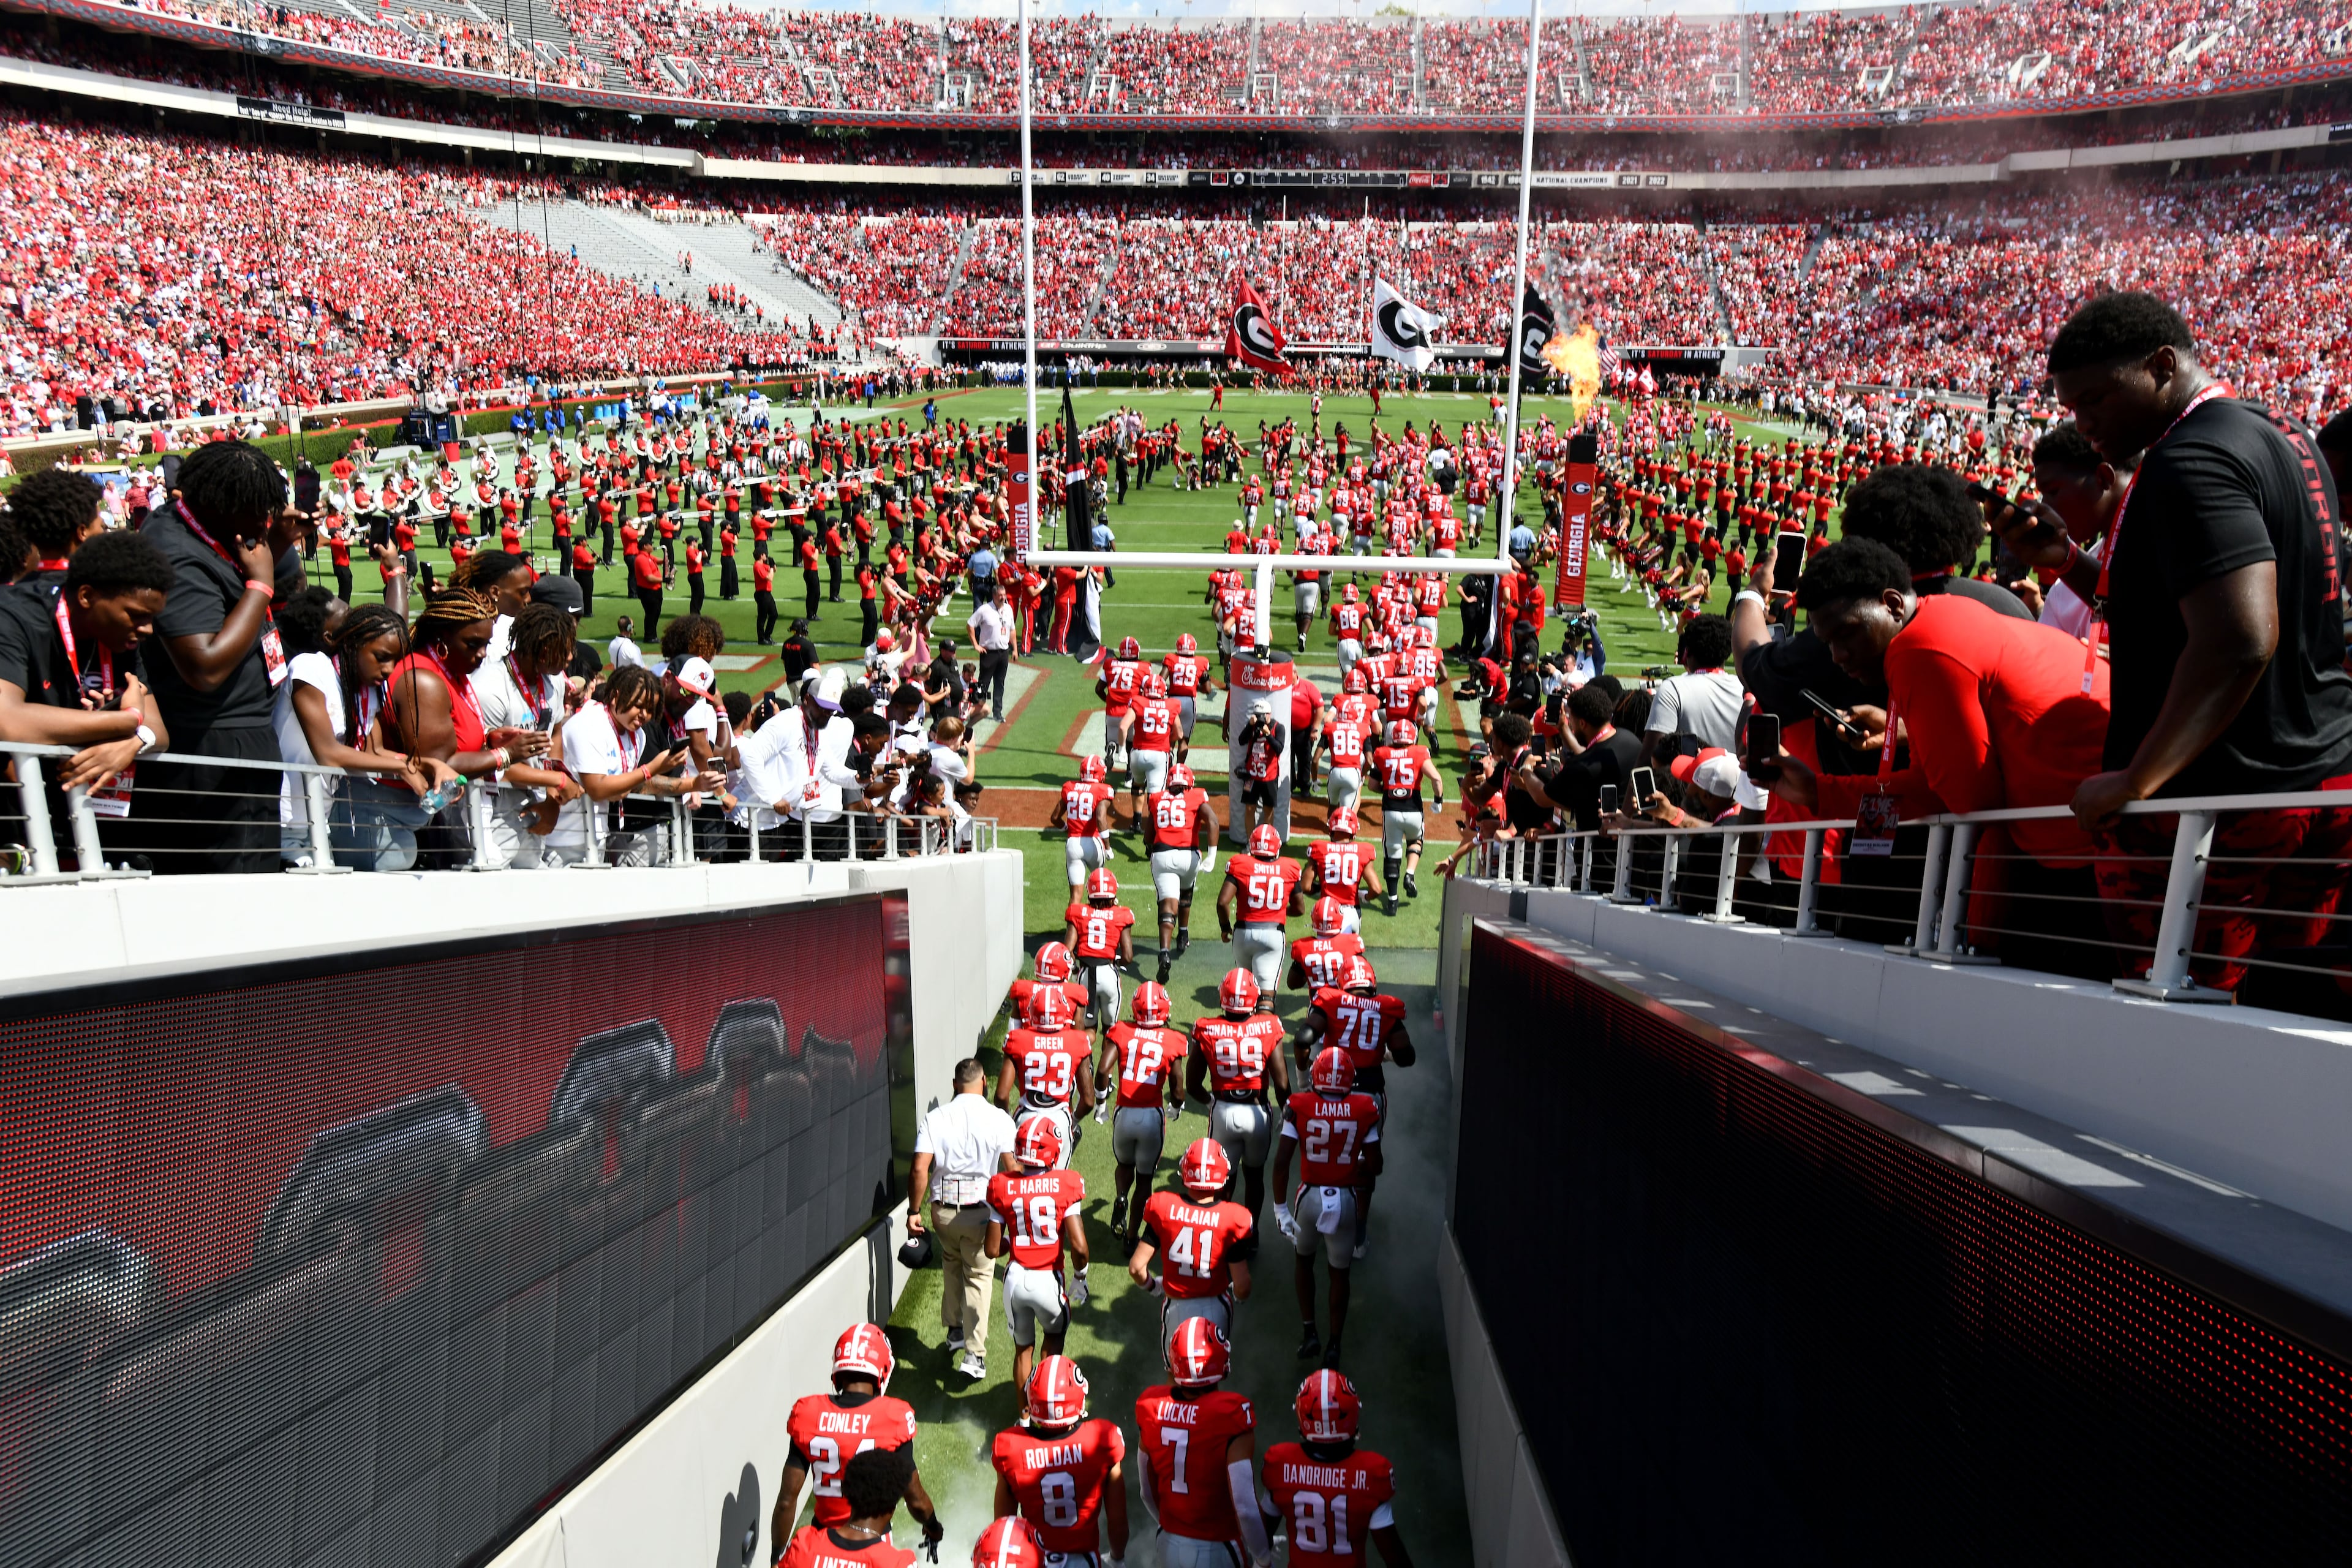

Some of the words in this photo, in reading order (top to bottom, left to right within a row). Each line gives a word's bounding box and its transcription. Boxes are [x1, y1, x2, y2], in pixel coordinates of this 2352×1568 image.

[1322, 173, 1344, 184] 2:55
[942, 341, 956, 350] IT'S
[957, 341, 990, 350] SATURDAY
[1001, 342, 1026, 350] ATHENS
[1631, 350, 1646, 358] IT'S
[1684, 350, 1692, 359] IN
[1694, 350, 1721, 360] ATHENS
[1014, 502, 1029, 564] GEORGIA
[1441, 524, 1456, 540] 76
[1567, 513, 1585, 577] GEORGIA
[1423, 586, 1439, 606] 12
[1340, 609, 1359, 630] 88
[1393, 633, 1415, 652] 47
[1172, 664, 1197, 687] 29
[1370, 662, 1386, 683] 11
[1415, 655, 1436, 677] 85
[1110, 667, 1134, 690] 79
[1384, 677, 1415, 685] MONTGOMERY
[1389, 685, 1409, 708] 15
[1142, 708, 1170, 734] 53
[1333, 731, 1360, 756] 86
[1390, 749, 1409, 758] SHORT
[1249, 761, 1267, 778] 33
[1385, 758, 1414, 786] 75
[1074, 783, 1092, 791] SMITH
[1066, 791, 1094, 821] 28
[1156, 799, 1186, 829] 66
[1327, 843, 1359, 853] PROTHRO
[1254, 864, 1275, 875] SMITH
[1275, 864, 1281, 876] II
[1324, 853, 1359, 886] 80
[1248, 875, 1284, 911] 50
[1082, 907, 1088, 917] D.
[1090, 907, 1114, 920] JONES
[1087, 918, 1106, 950] 8
[1313, 940, 1333, 951] PEAL
[1304, 951, 1343, 988] 30
[1341, 994, 1381, 1011] CALHOUN
[1336, 1007, 1382, 1050] 70
[1034, 1036, 1064, 1050] GREEN
[1122, 1038, 1164, 1085] 12
[1215, 1037, 1263, 1079] 99
[1024, 1051, 1072, 1096] 23
[1314, 1102, 1351, 1117] LAMAR
[1306, 1118, 1358, 1165] 27
[1007, 1179, 1017, 1195] C.
[1019, 1177, 1060, 1194] HARRIS
[1012, 1195, 1058, 1248] 18
[1169, 1204, 1220, 1228] LALAIAN
[1167, 1226, 1213, 1280] 41
[1196, 1362, 1204, 1376] 7
[819, 1411, 871, 1434] CONLEY
[1055, 1405, 1064, 1418] 8
[1157, 1401, 1199, 1425] LUCKIE
[1242, 1401, 1253, 1425] 7
[1314, 1420, 1338, 1434] 81
[809, 1436, 876, 1498] 2
[1025, 1443, 1083, 1470] ROLDAN
[1161, 1426, 1189, 1494] 7
[1283, 1463, 1347, 1489] DANDRIDGE
[1351, 1469, 1370, 1490] JR.
[1040, 1471, 1079, 1527] 8
[1292, 1490, 1353, 1555] 81
